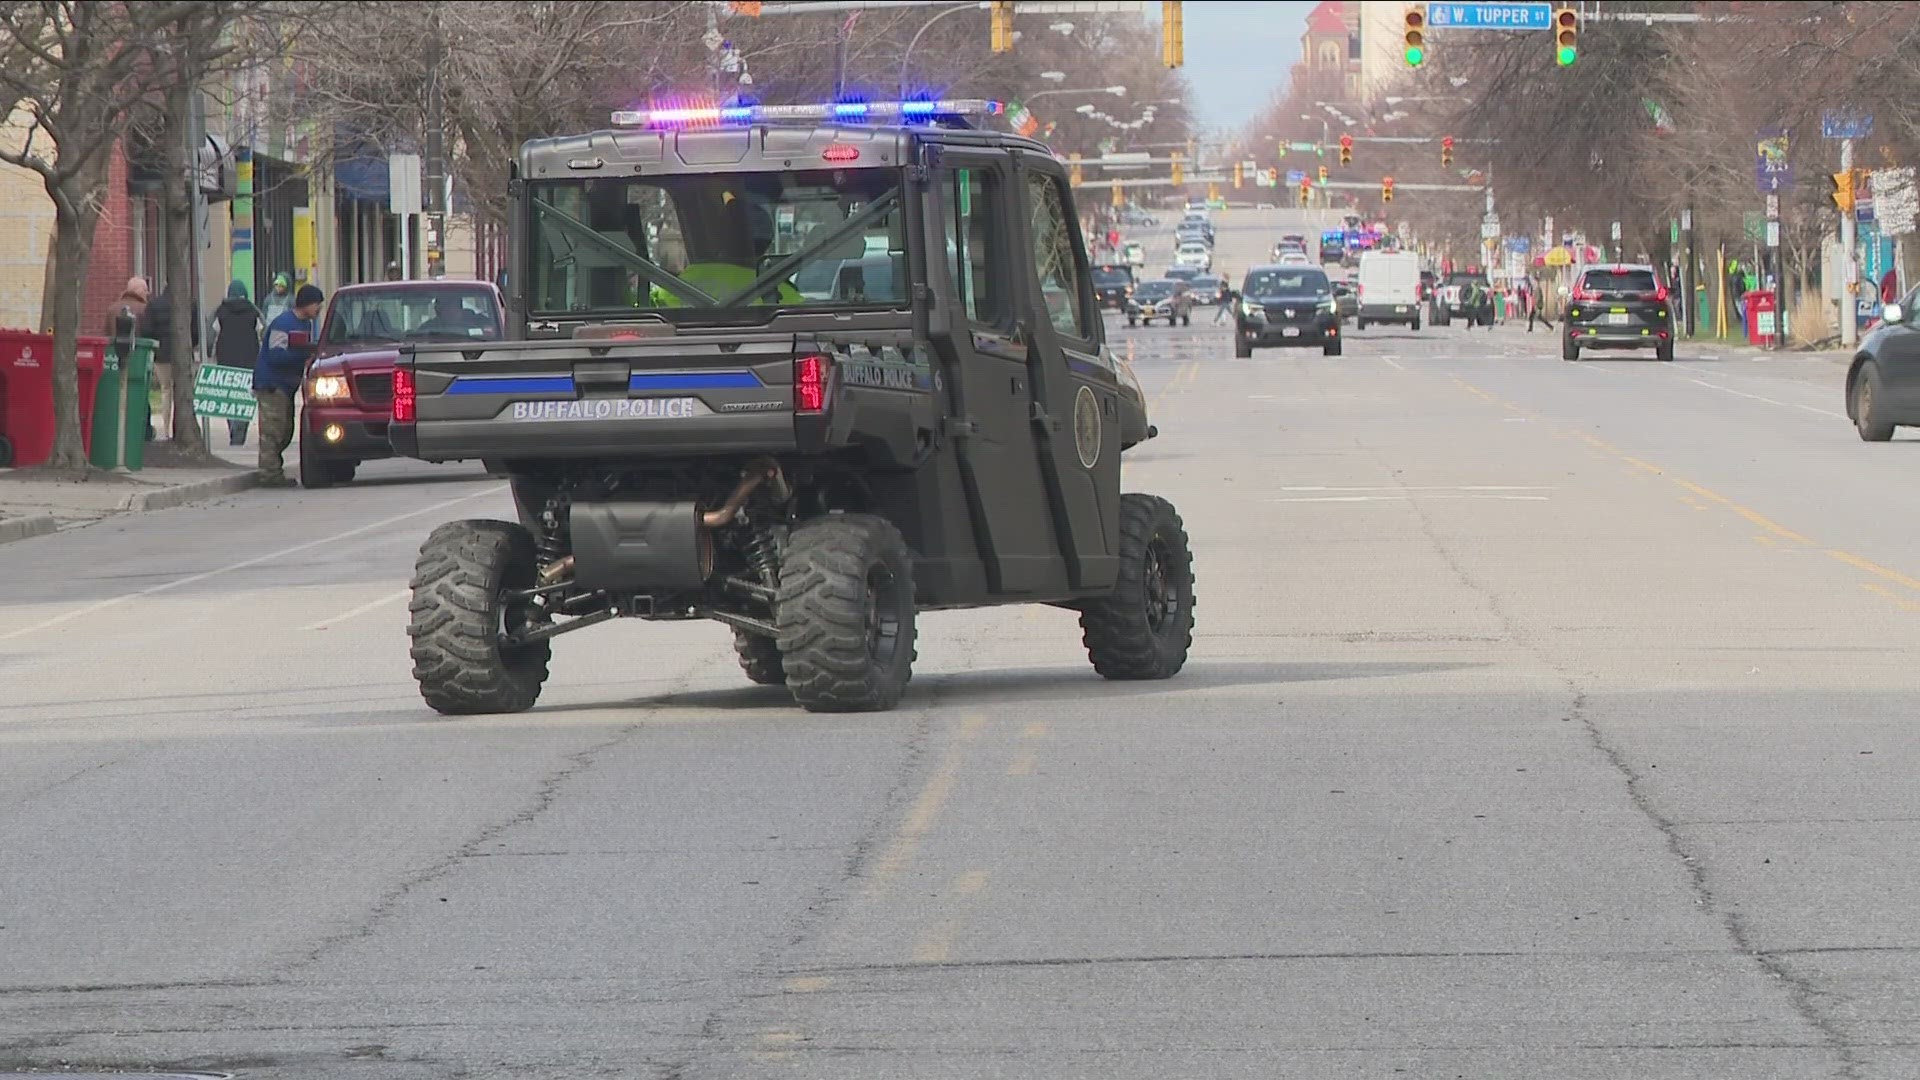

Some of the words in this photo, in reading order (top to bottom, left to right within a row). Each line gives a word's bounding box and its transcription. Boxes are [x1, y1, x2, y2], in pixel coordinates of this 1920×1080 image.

[1453, 7, 1468, 22] W.
[1476, 8, 1529, 23] TUPPER
[1535, 11, 1544, 21] ST
[844, 363, 881, 384] BUFFALO
[883, 366, 913, 389] POLICE
[513, 401, 610, 419] BUFFALO
[616, 398, 693, 417] POLICE
